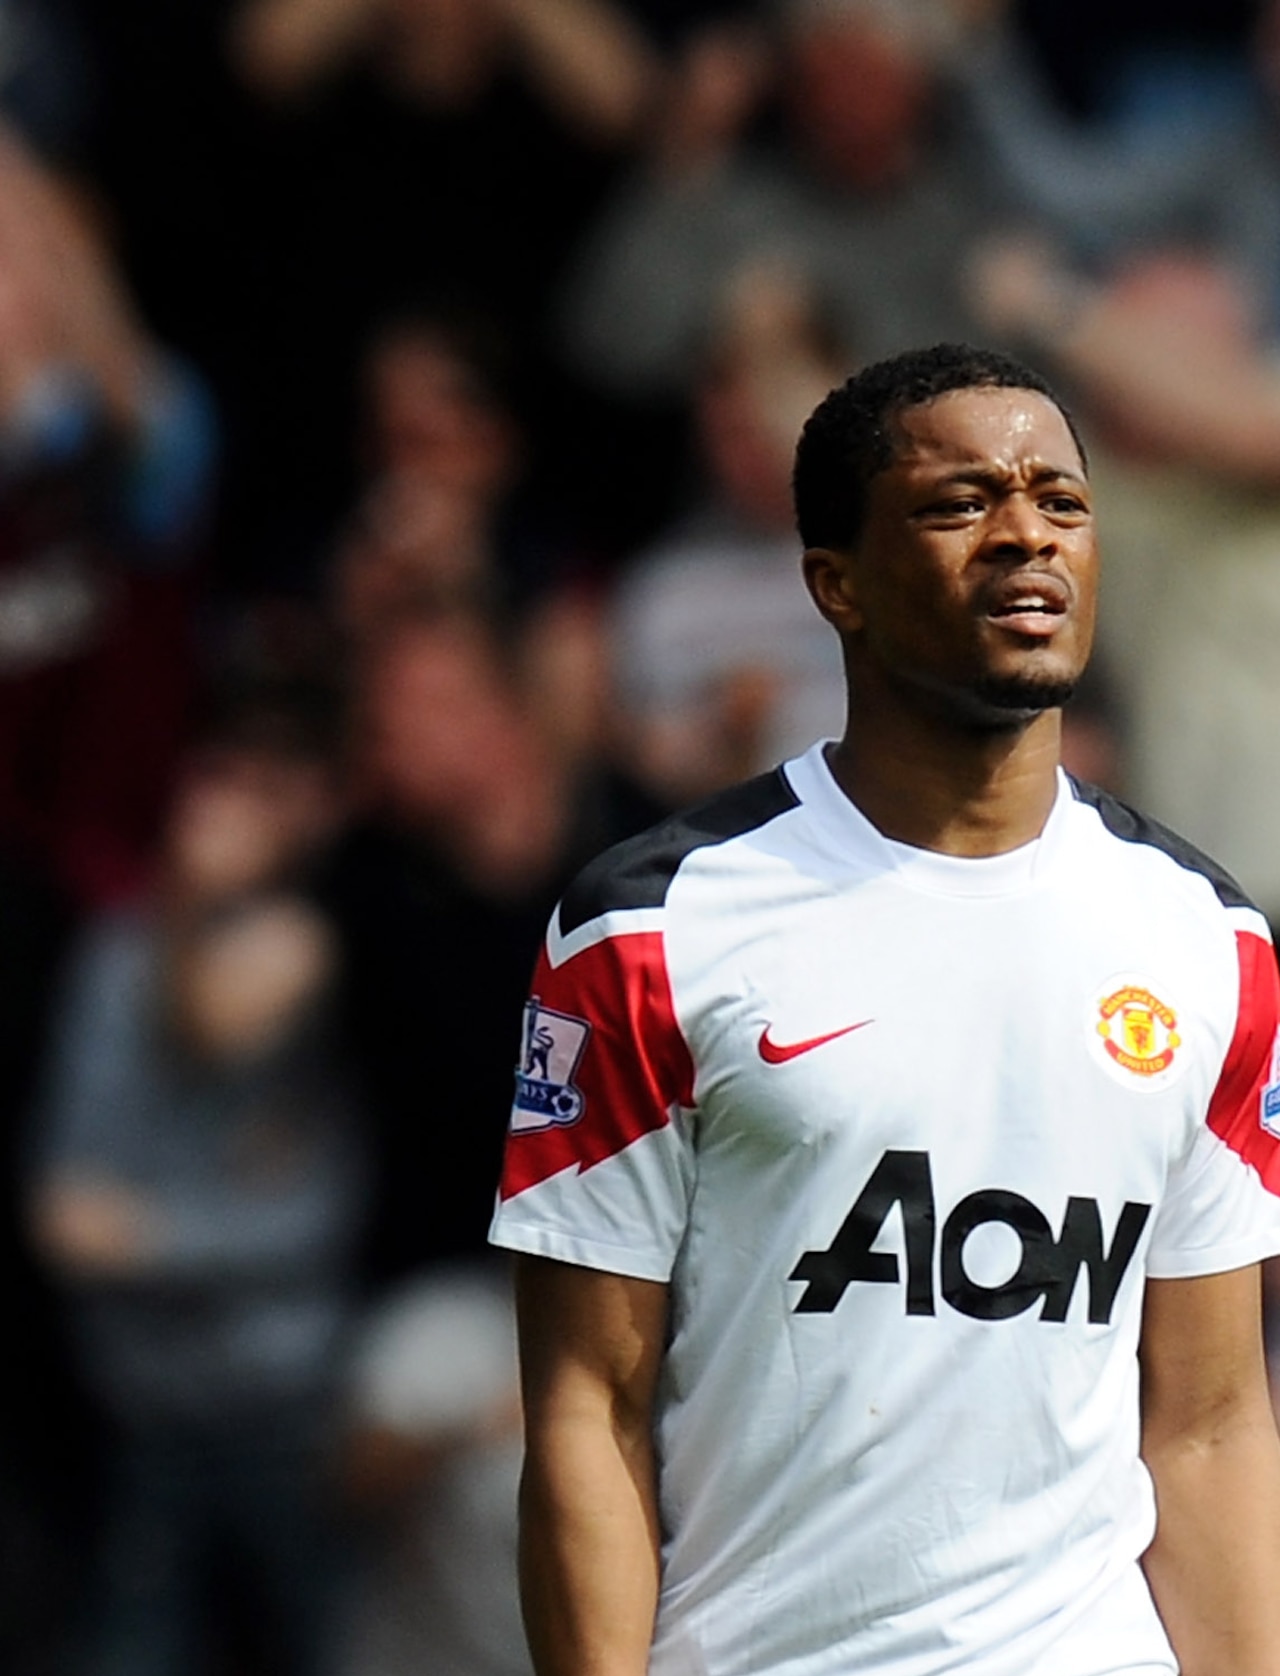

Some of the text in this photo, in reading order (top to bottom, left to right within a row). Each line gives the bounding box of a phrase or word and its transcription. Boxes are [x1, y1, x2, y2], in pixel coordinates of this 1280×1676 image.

[1101, 989, 1175, 1028] MANCHESTER
[1117, 1051, 1164, 1071] UNITED
[789, 1150, 1152, 1325] AON
